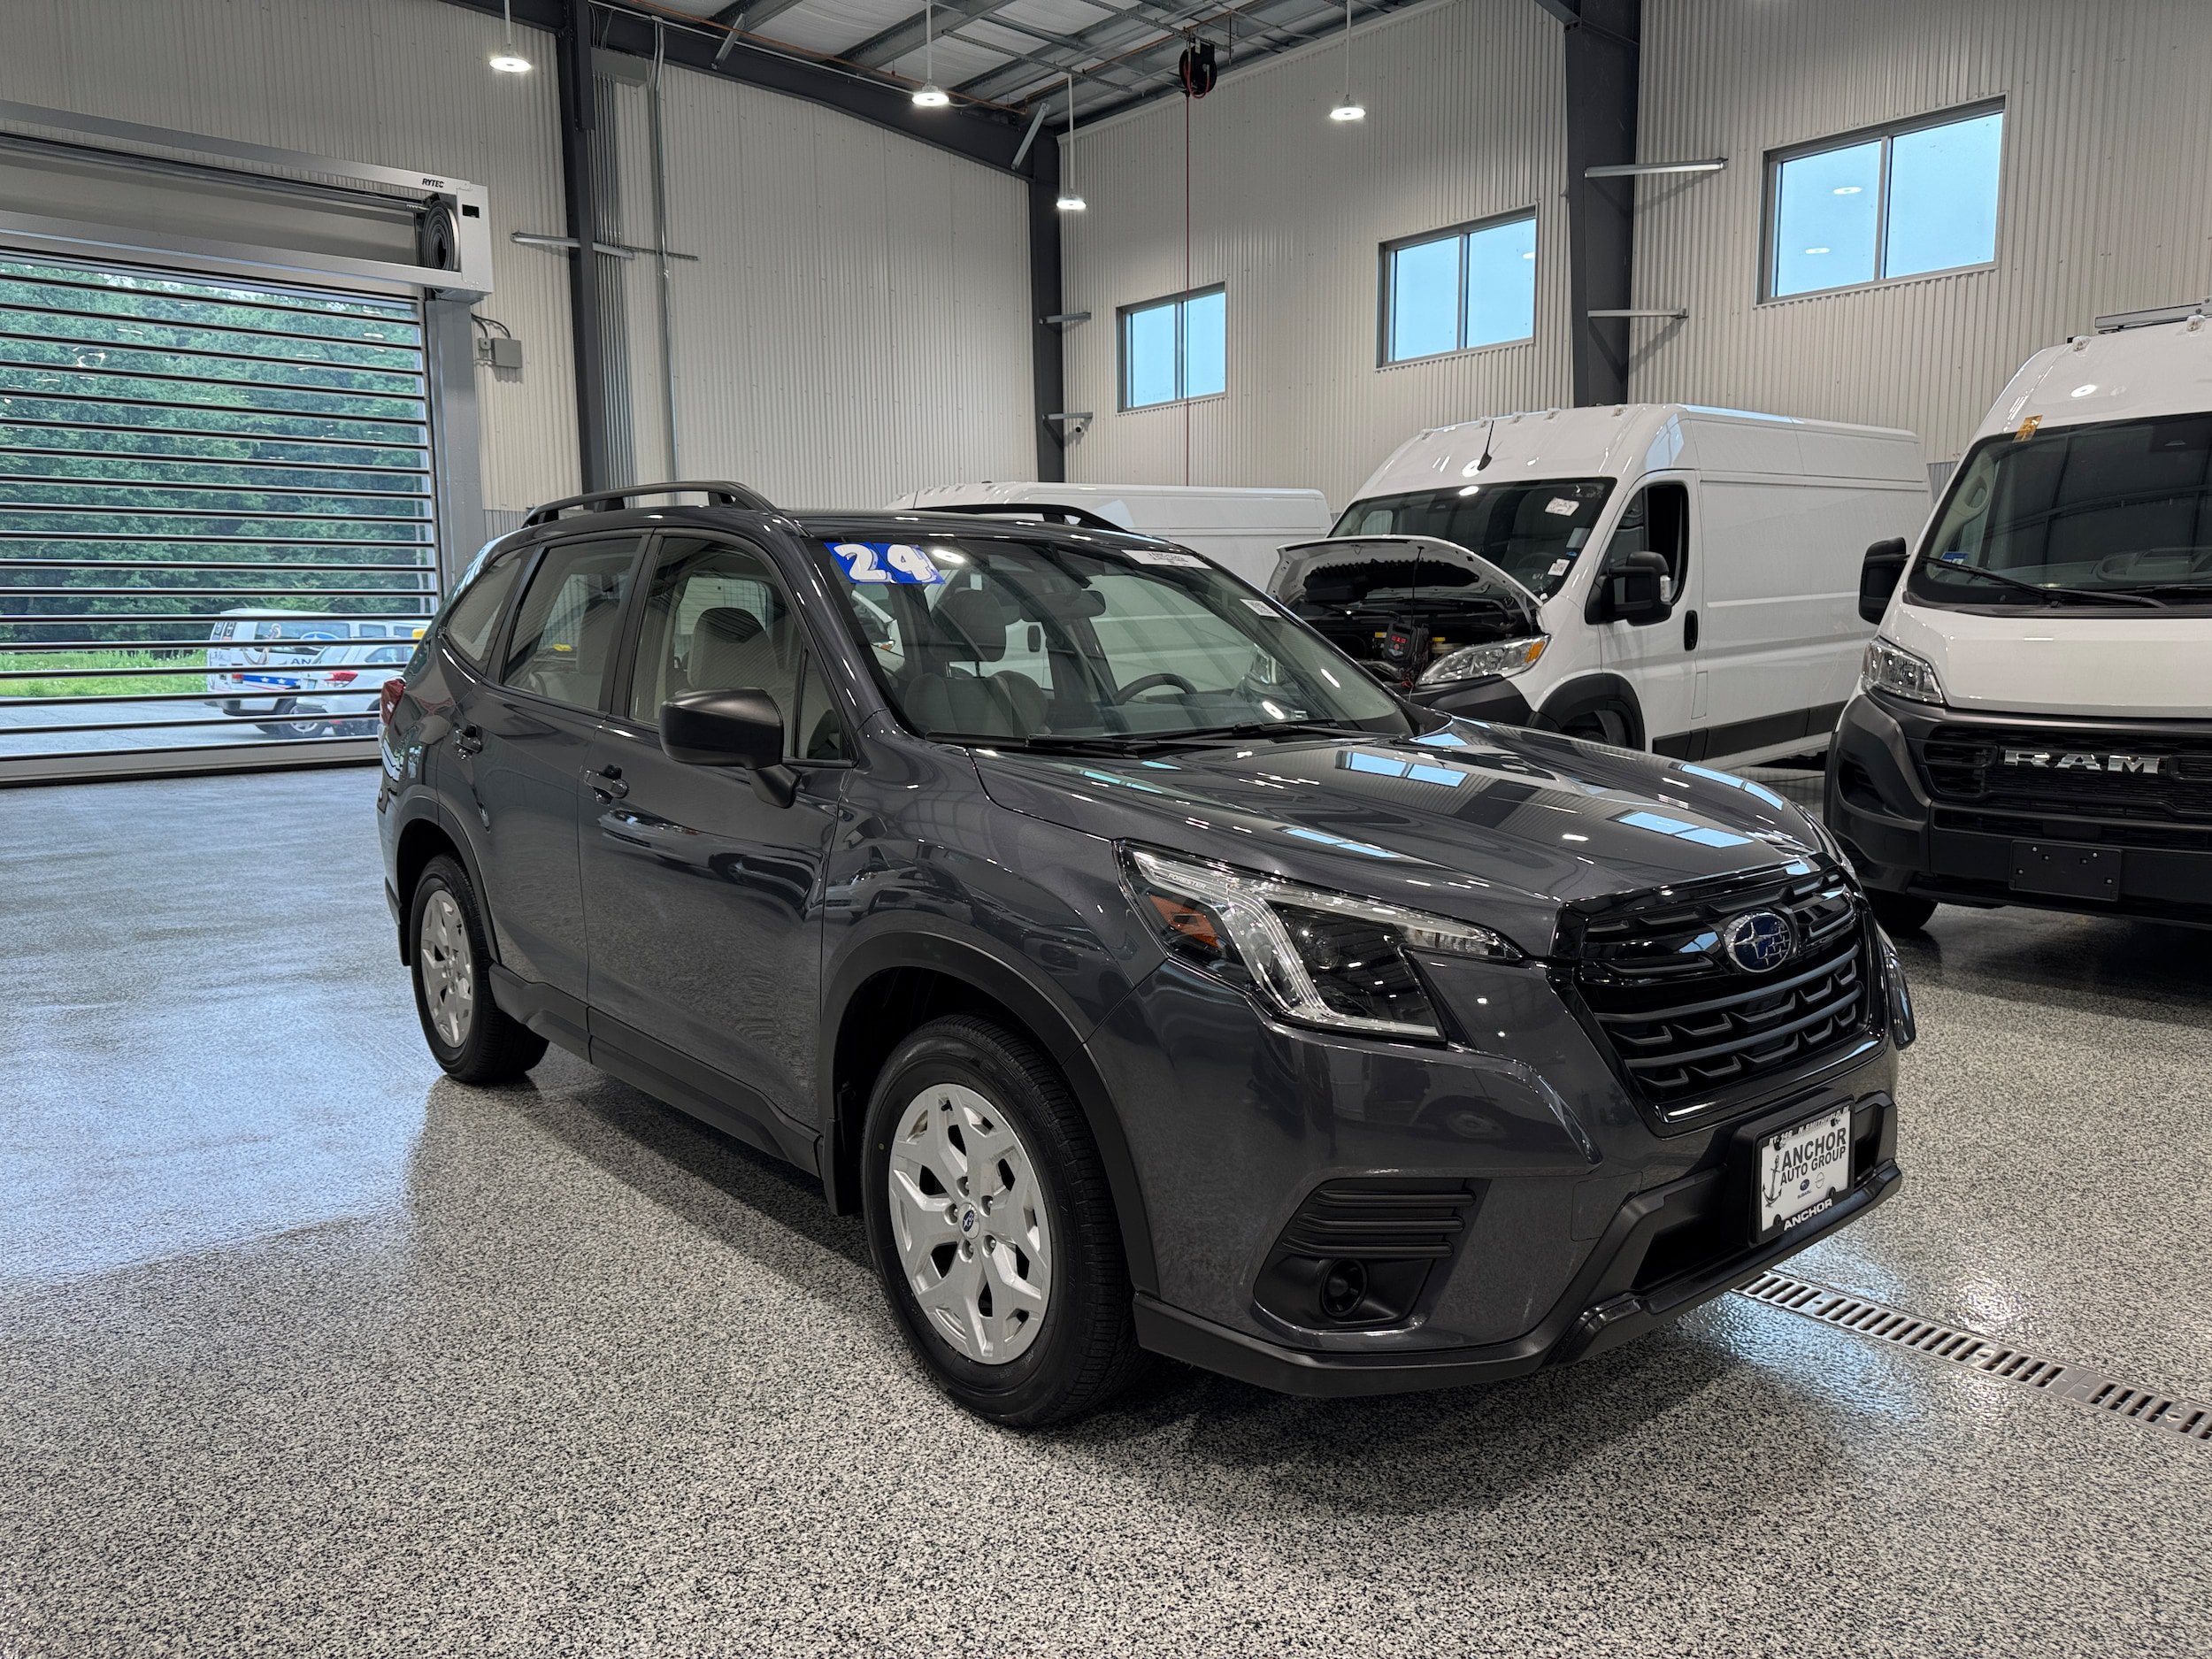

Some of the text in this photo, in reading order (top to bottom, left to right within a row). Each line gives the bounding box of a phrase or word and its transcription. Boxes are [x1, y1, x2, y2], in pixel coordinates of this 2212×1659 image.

[421, 178, 444, 188] RYTEC
[833, 543, 937, 583] 24
[2004, 749, 2160, 774] RAM
[1167, 872, 1207, 889] FORESTER
[1782, 1127, 1847, 1171] ANCHOR
[1780, 1146, 1847, 1187] AUTO GROUP
[1783, 1198, 1833, 1232] ANCHOR
